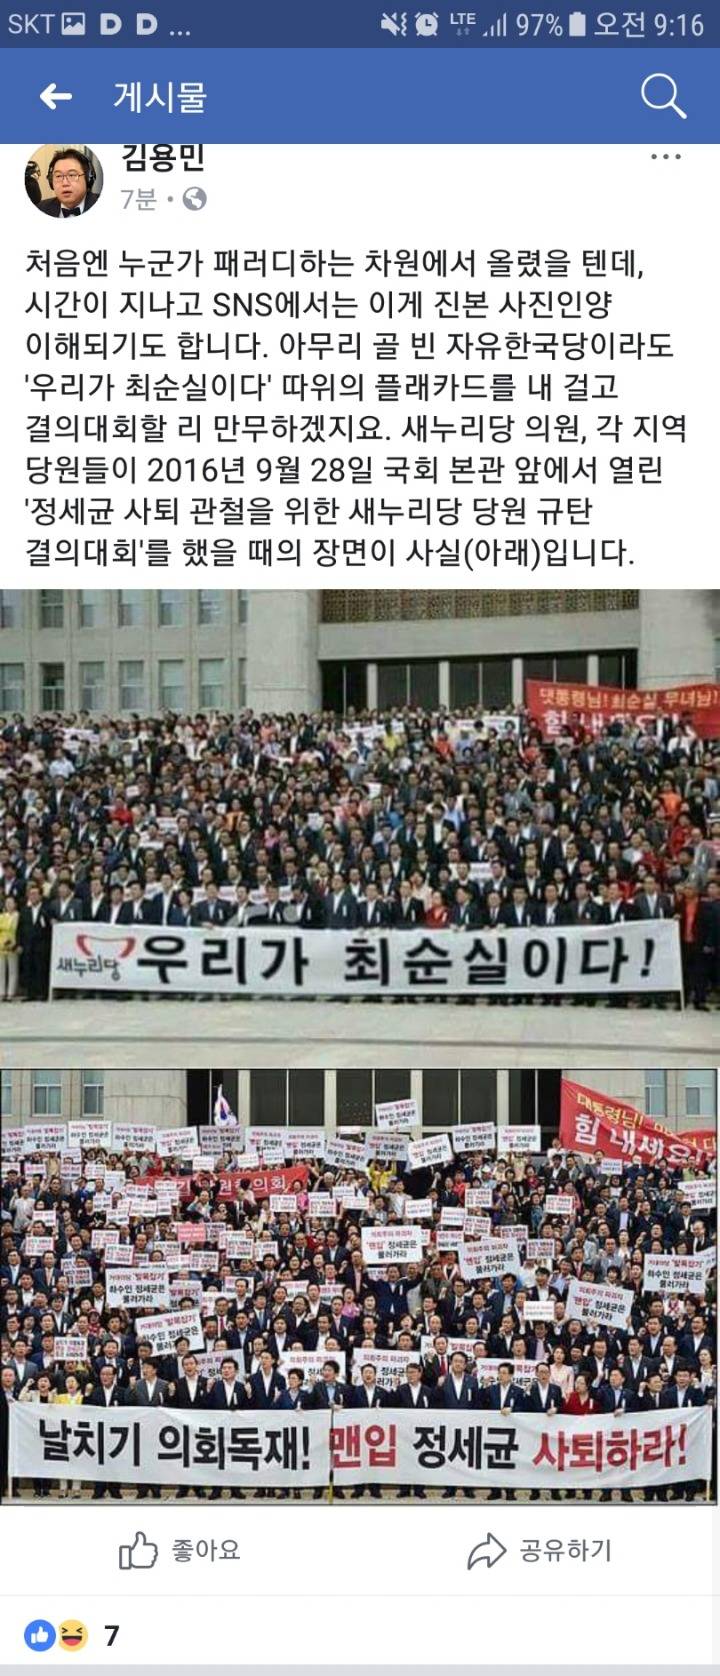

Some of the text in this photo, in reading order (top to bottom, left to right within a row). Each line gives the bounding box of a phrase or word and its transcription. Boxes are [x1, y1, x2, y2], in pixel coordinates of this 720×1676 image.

[8, 13, 56, 35] SKT
[450, 12, 477, 25] LTE
[516, 13, 563, 37] 97%
[594, 11, 704, 38] 오전 9:16
[113, 81, 208, 114] 게시물
[121, 144, 205, 173] 김용민
[120, 188, 157, 211] 7분
[26, 249, 643, 279] 처음엔 누군가 패러디하는 차원에서 올렸을 텐데,
[24, 290, 613, 319] 시간이 지나고 SNS에서는 이게 진본 사진인양
[26, 331, 674, 361] 이해되기도 합니다. 아무리 골 빈 자유한국당이라도
[25, 373, 619, 402] '우리가 최순실이다' 따위의 플래카드를 내 걸고
[26, 414, 686, 444] 결의대회할 리 만무하겠지요. 새누리당 의원, 각 지역
[26, 455, 662, 485] 당원들이 2016년 9월 28일 국회 본관 앞에서 열린
[25, 497, 593, 526] '정세균 사퇴 관철을 위한 새누리당 당원 규탄
[26, 537, 634, 572] 결의대회'를 했을 때의 장면이 사실(아래)입니다.
[611, 691, 657, 709] 최순실
[57, 955, 121, 982] 새누리당
[136, 934, 656, 987] 우리가 최순실이다!
[577, 1092, 644, 1130] 대통령님!
[575, 1113, 600, 1146] 힘
[38, 1418, 311, 1471] 날치기 의회독재!
[329, 1423, 688, 1472] 맨입 정세균 사퇴하라!
[171, 1538, 241, 1563] 좋아요
[519, 1538, 611, 1563] 공유하기
[104, 1624, 120, 1647] 7
